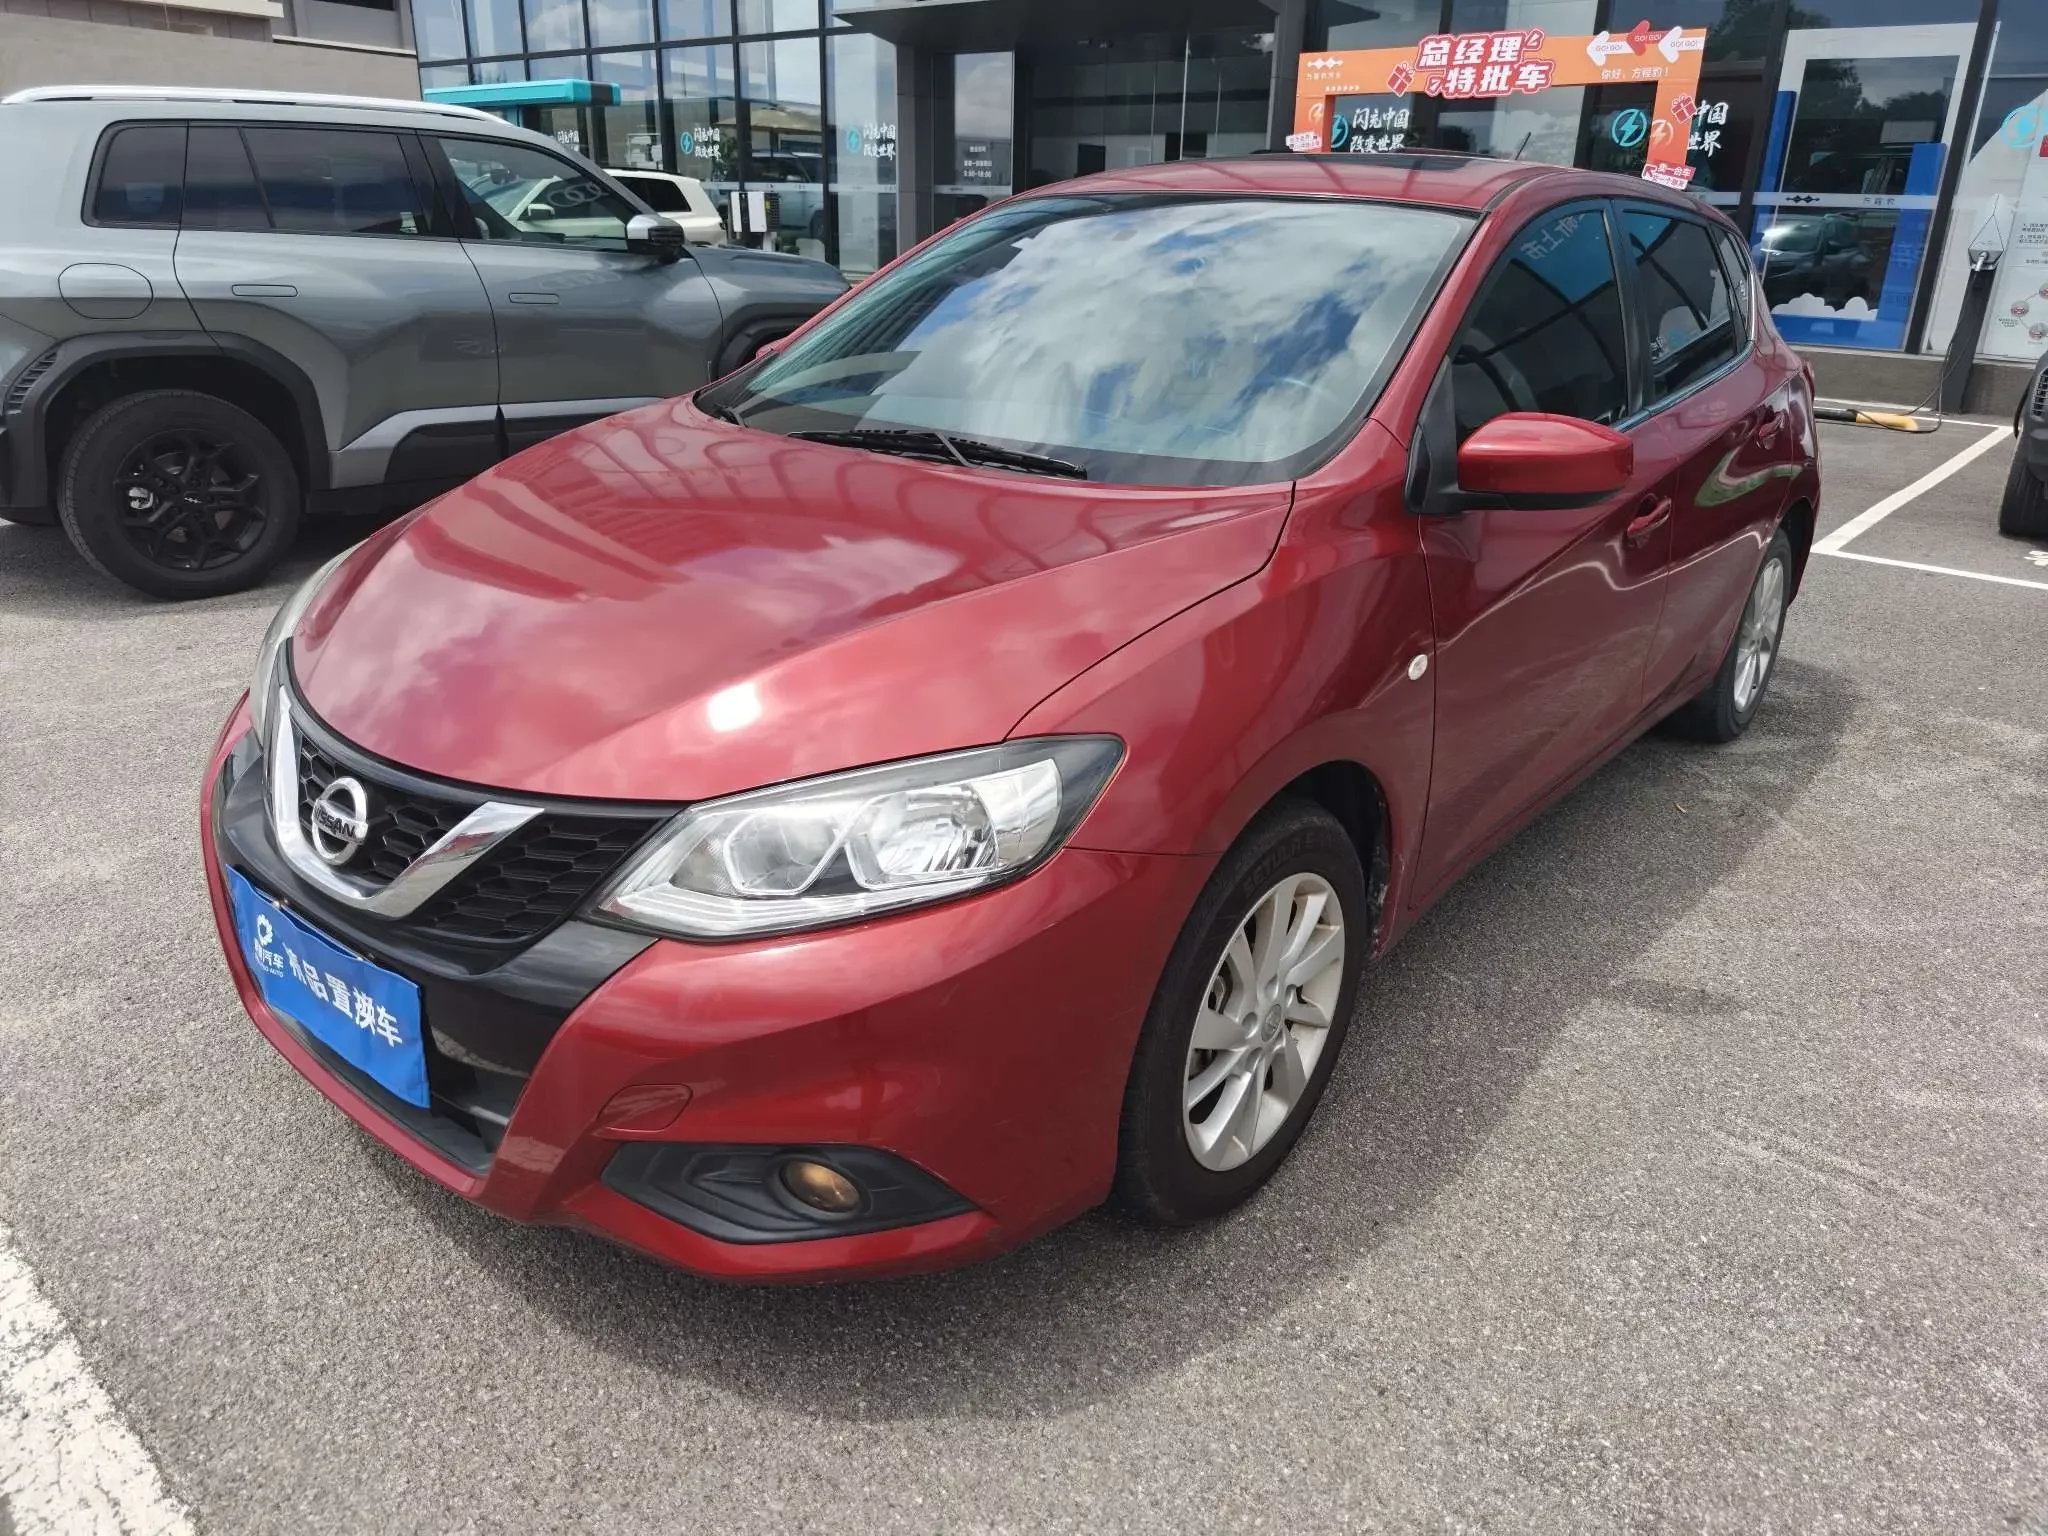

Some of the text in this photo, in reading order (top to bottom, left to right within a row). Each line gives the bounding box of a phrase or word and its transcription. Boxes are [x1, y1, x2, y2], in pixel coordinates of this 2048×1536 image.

[1419, 36, 1522, 67] 总经理
[1445, 63, 1550, 93] 特批车
[1352, 107, 1410, 130] 闪充中国
[1350, 133, 1406, 153] 改变世界
